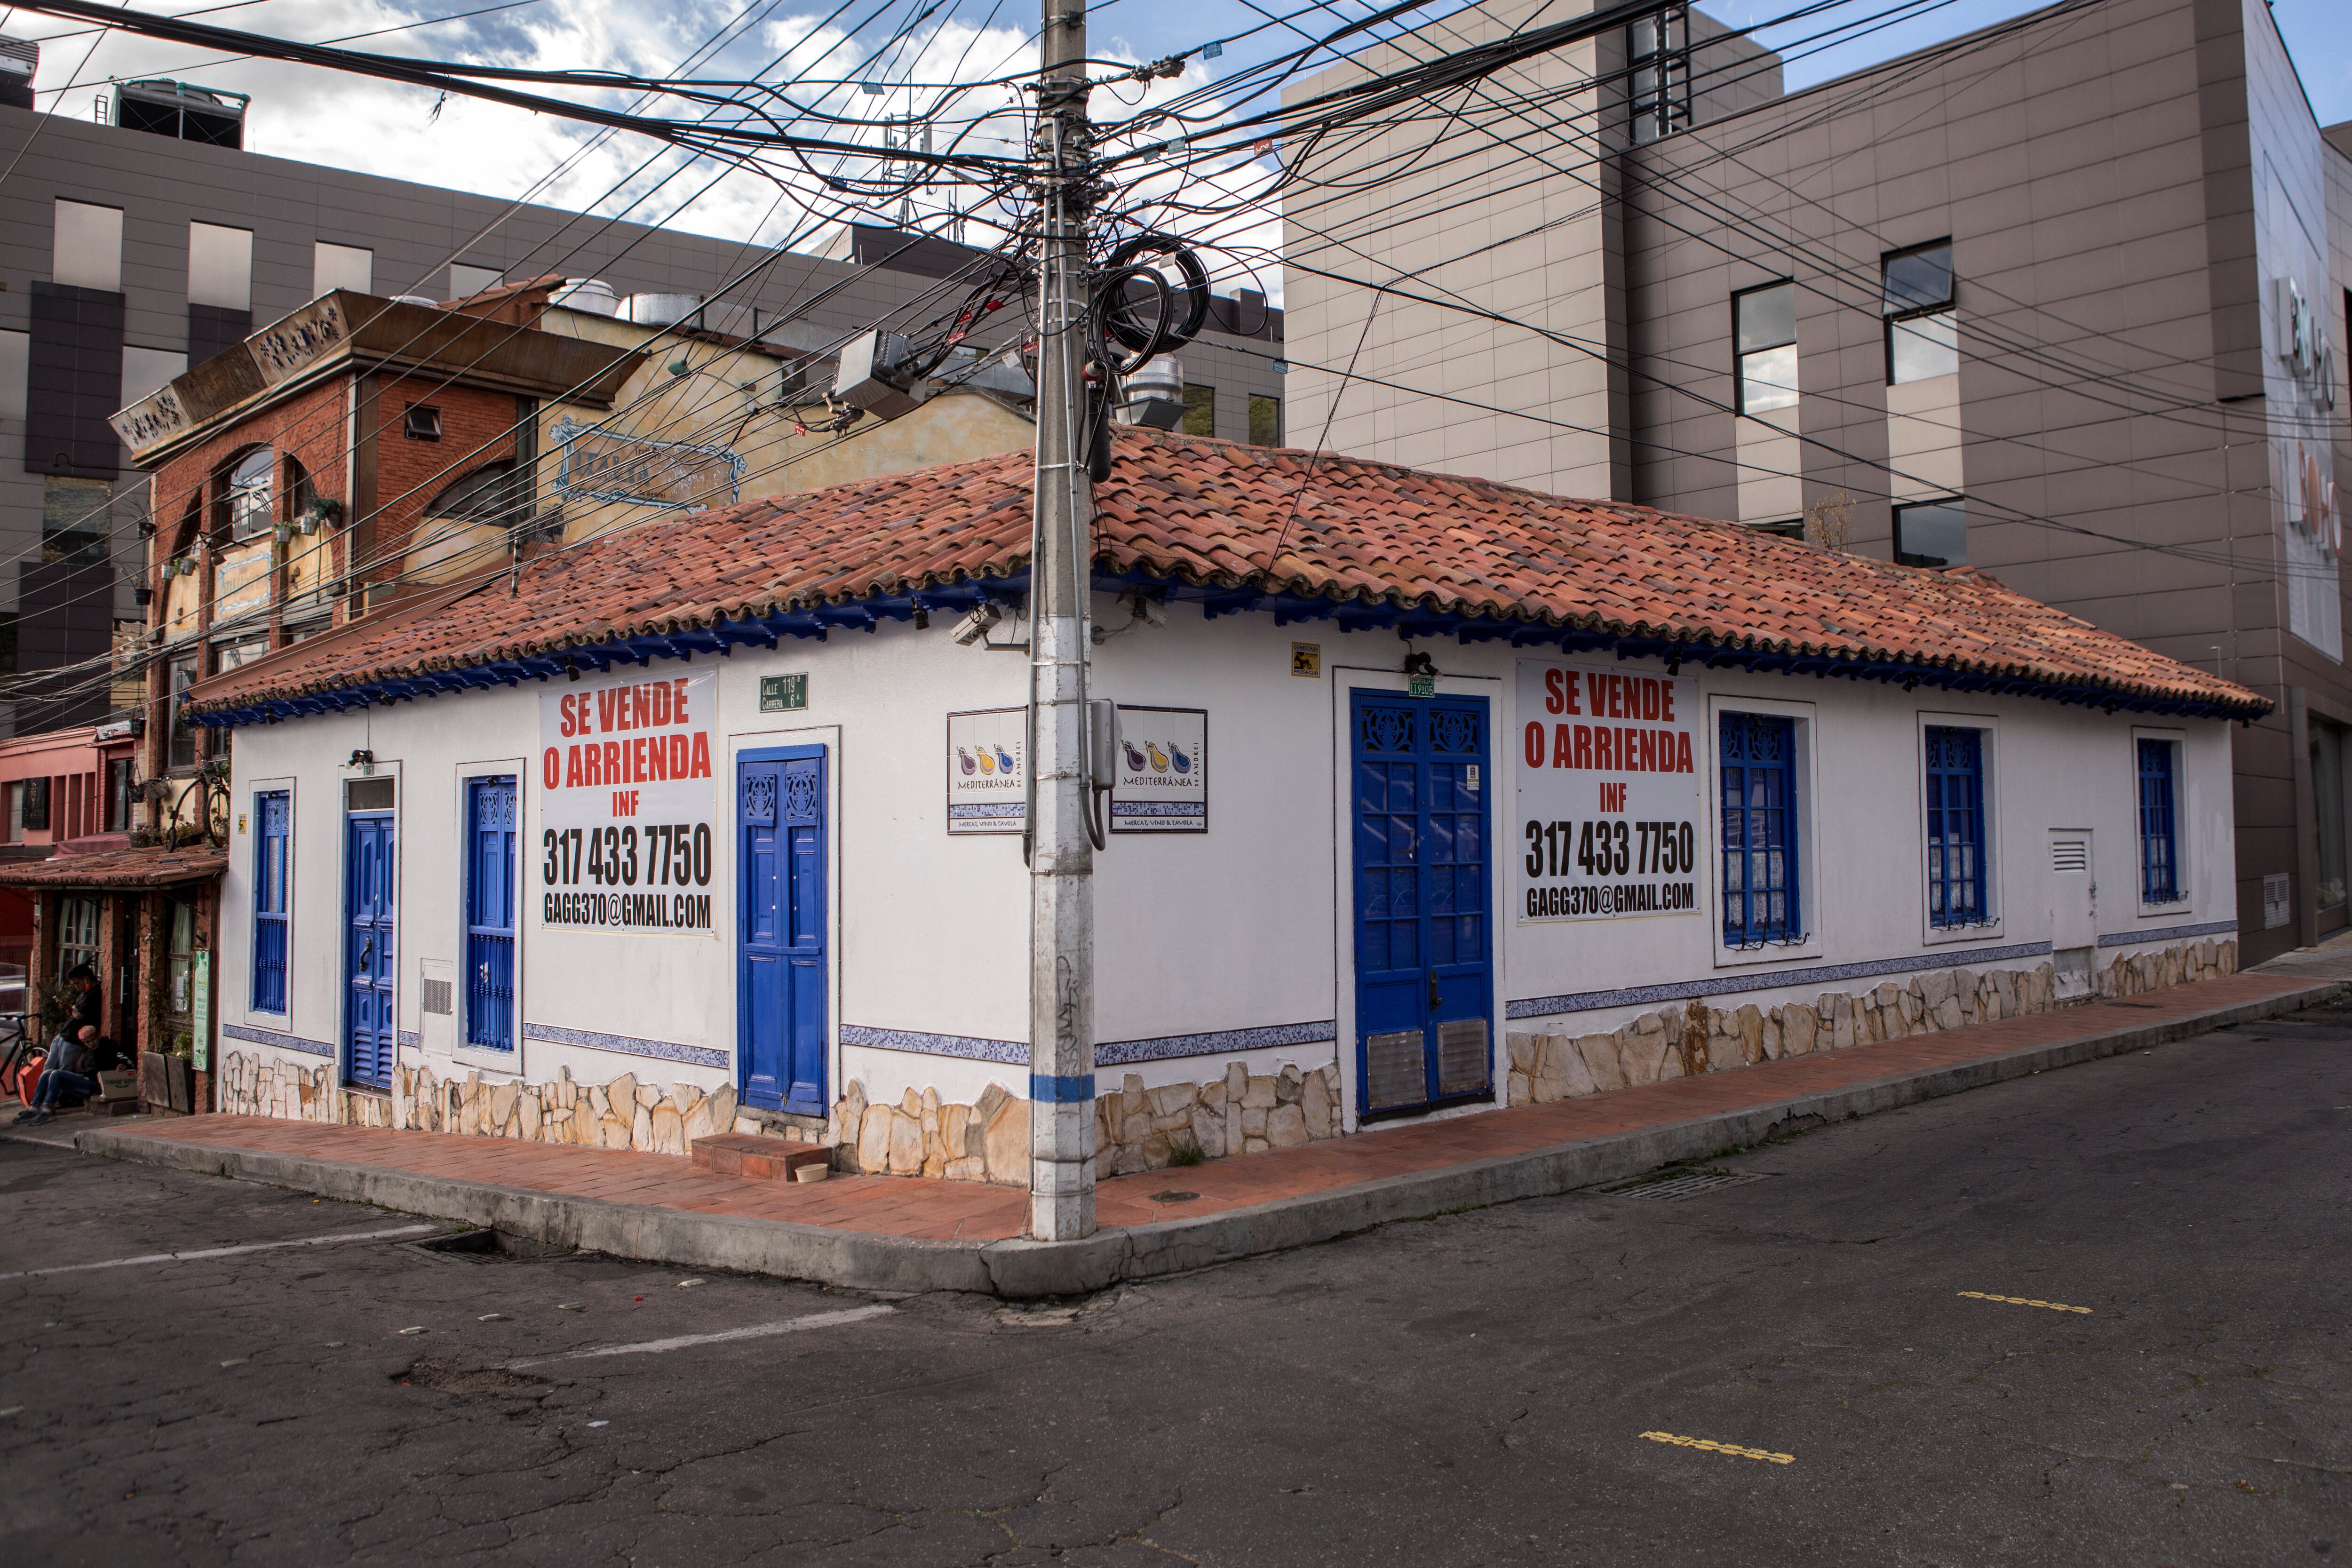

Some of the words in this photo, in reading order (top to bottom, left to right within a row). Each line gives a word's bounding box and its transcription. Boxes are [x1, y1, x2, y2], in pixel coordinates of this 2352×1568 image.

[763, 680, 778, 696] CALLE
[783, 677, 795, 694] 119
[763, 697, 783, 710] CARRERA
[791, 694, 795, 707] 6
[1545, 668, 1580, 715] SE
[1587, 672, 1675, 722] VENDE
[560, 692, 591, 738] SE
[597, 677, 689, 733] VENDE
[543, 747, 560, 790] O
[566, 731, 712, 788] ARRIENDA
[1525, 721, 1545, 768] O
[1553, 724, 1694, 773] ARRIENDA
[958, 779, 1016, 790] MEDITERRÁNEA
[1017, 777, 1021, 788] DE
[1123, 775, 1192, 787] MEDITERRÁNEA
[1194, 776, 1199, 787] DE
[1600, 782, 1627, 812] INF
[612, 790, 639, 817] INF
[543, 828, 582, 886] 317
[588, 826, 637, 886] 433
[644, 822, 712, 886] 7750
[1526, 820, 1572, 878] 317
[1578, 820, 1629, 876] 433
[1636, 820, 1694, 875] 7750
[544, 892, 711, 929] GAGG370@GMAIL.COM
[1526, 883, 1694, 917] GAGG370@GMAIL.COM
